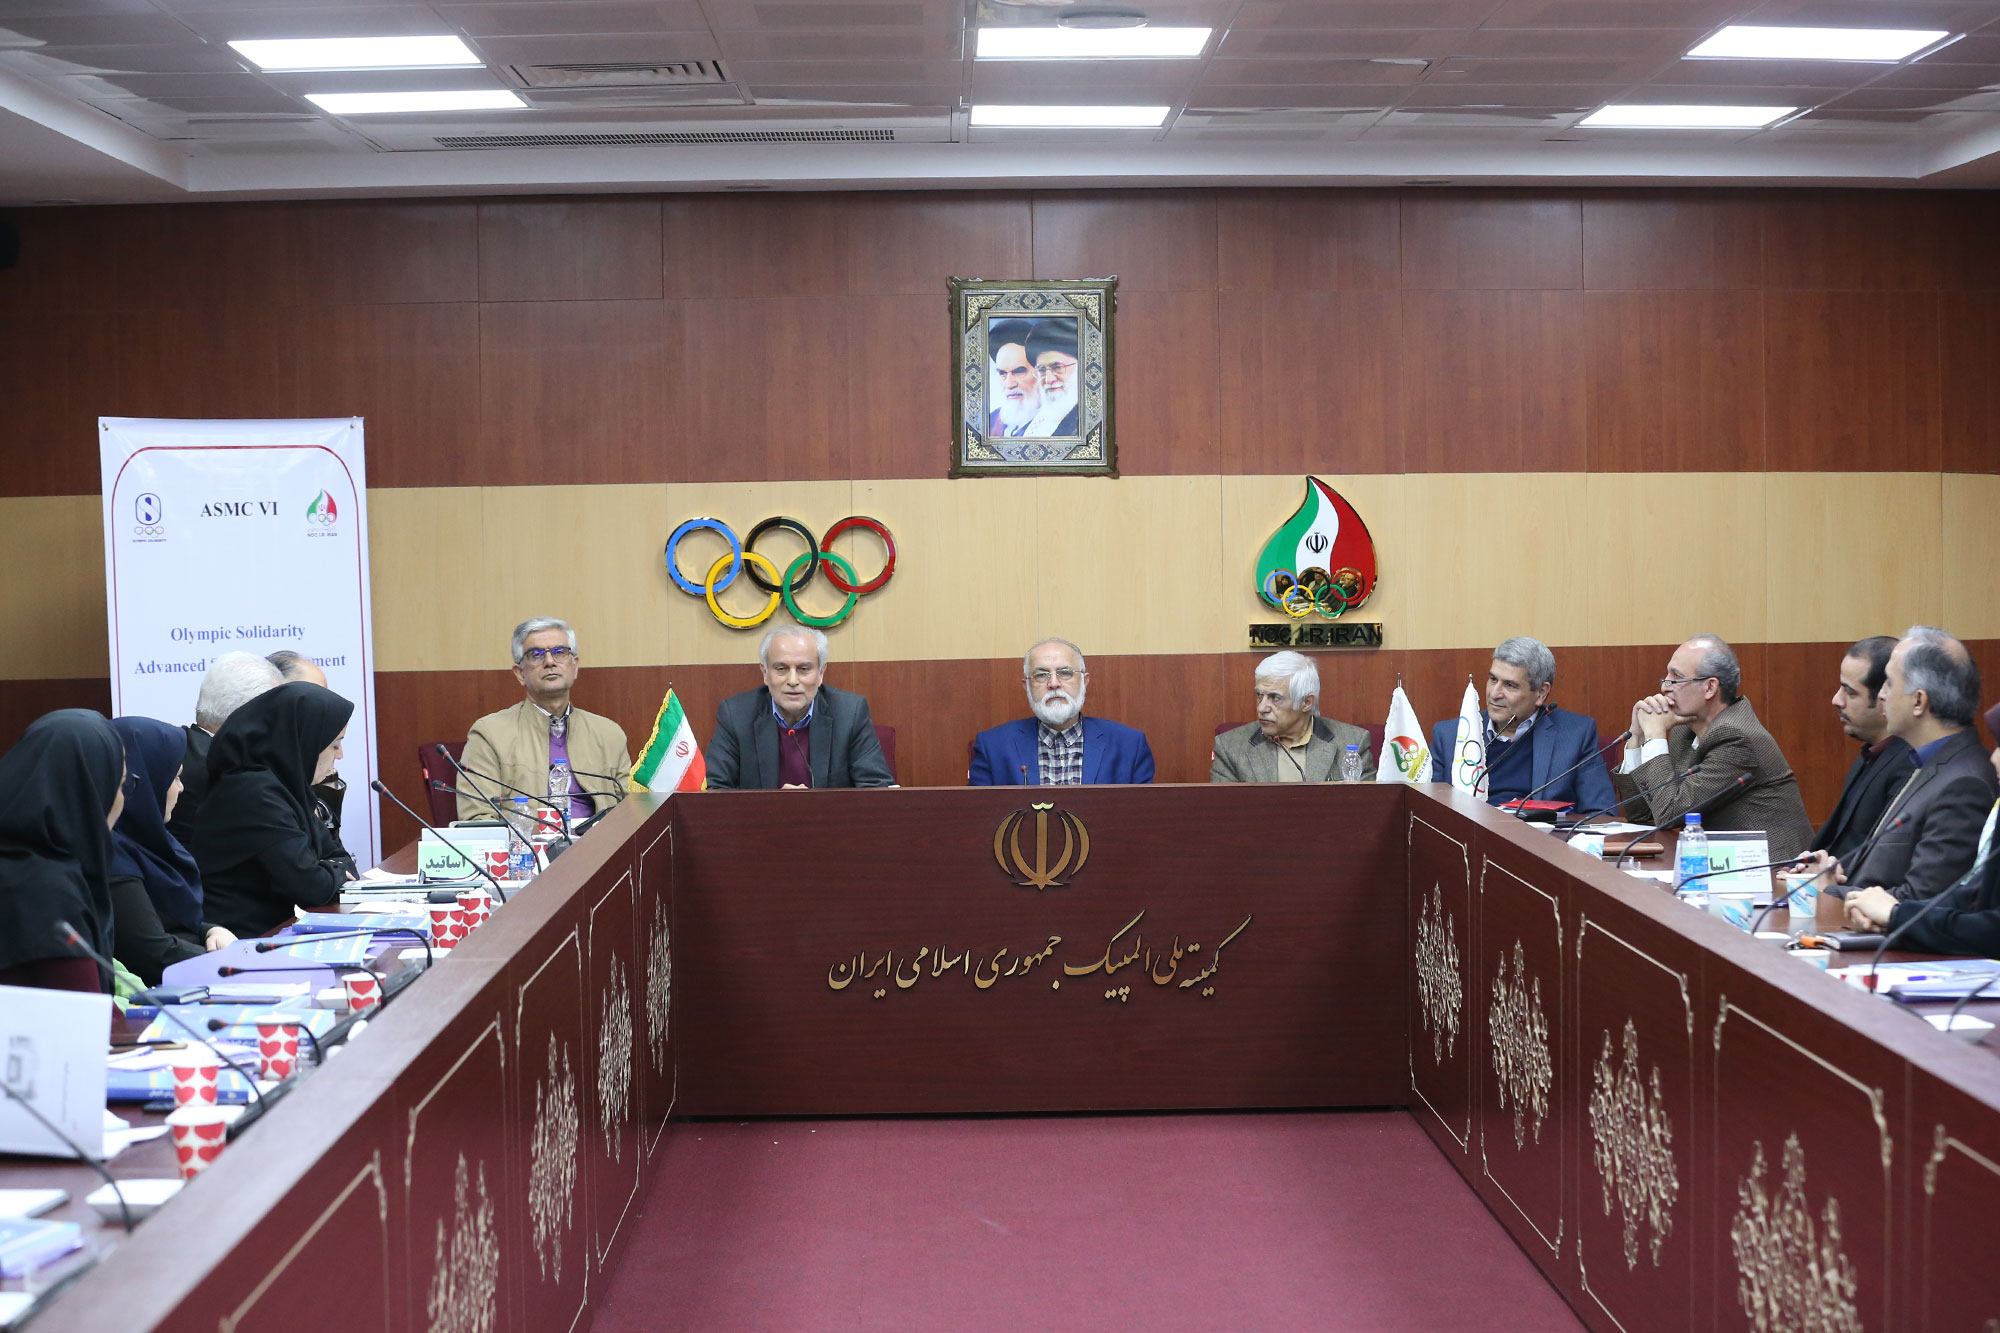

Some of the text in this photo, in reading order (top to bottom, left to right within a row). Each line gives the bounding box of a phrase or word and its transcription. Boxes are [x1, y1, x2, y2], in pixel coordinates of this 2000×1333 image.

[200, 501, 279, 517] ASMC VI
[170, 624, 305, 644] Olympic Solidarity
[1251, 627, 1292, 644] NOC
[134, 659, 206, 675] Advanced
[828, 909, 1252, 1003] کمیته ملی المپیک جمهوری اسلامی ایران
